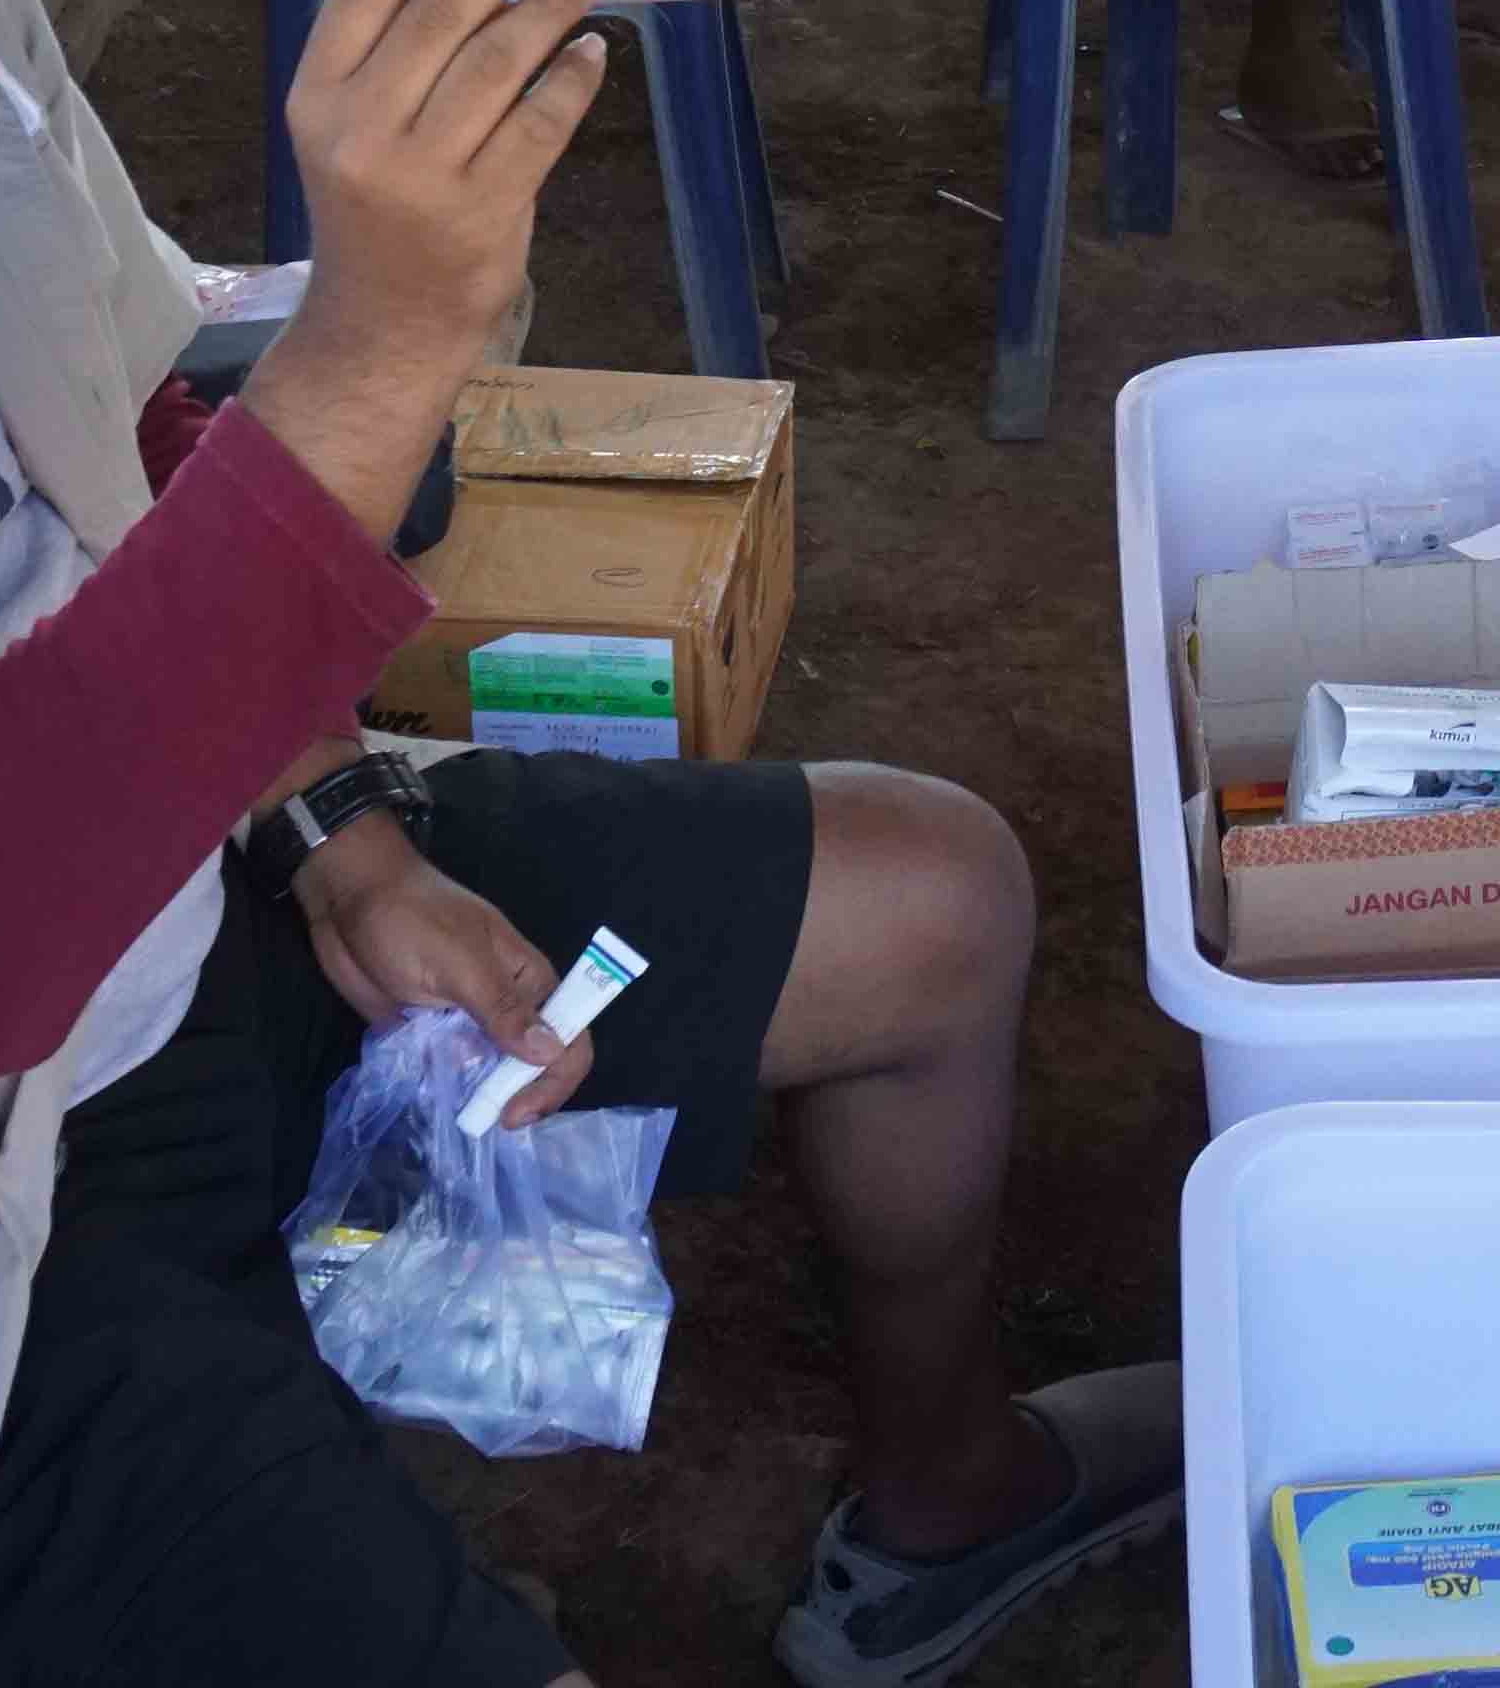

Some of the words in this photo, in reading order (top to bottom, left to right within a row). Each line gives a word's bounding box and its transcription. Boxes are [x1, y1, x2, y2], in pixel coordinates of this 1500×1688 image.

[1345, 885, 1472, 916] JANGAN
[1427, 1525, 1467, 1536] ANTI
[1430, 1577, 1475, 1598] AG
